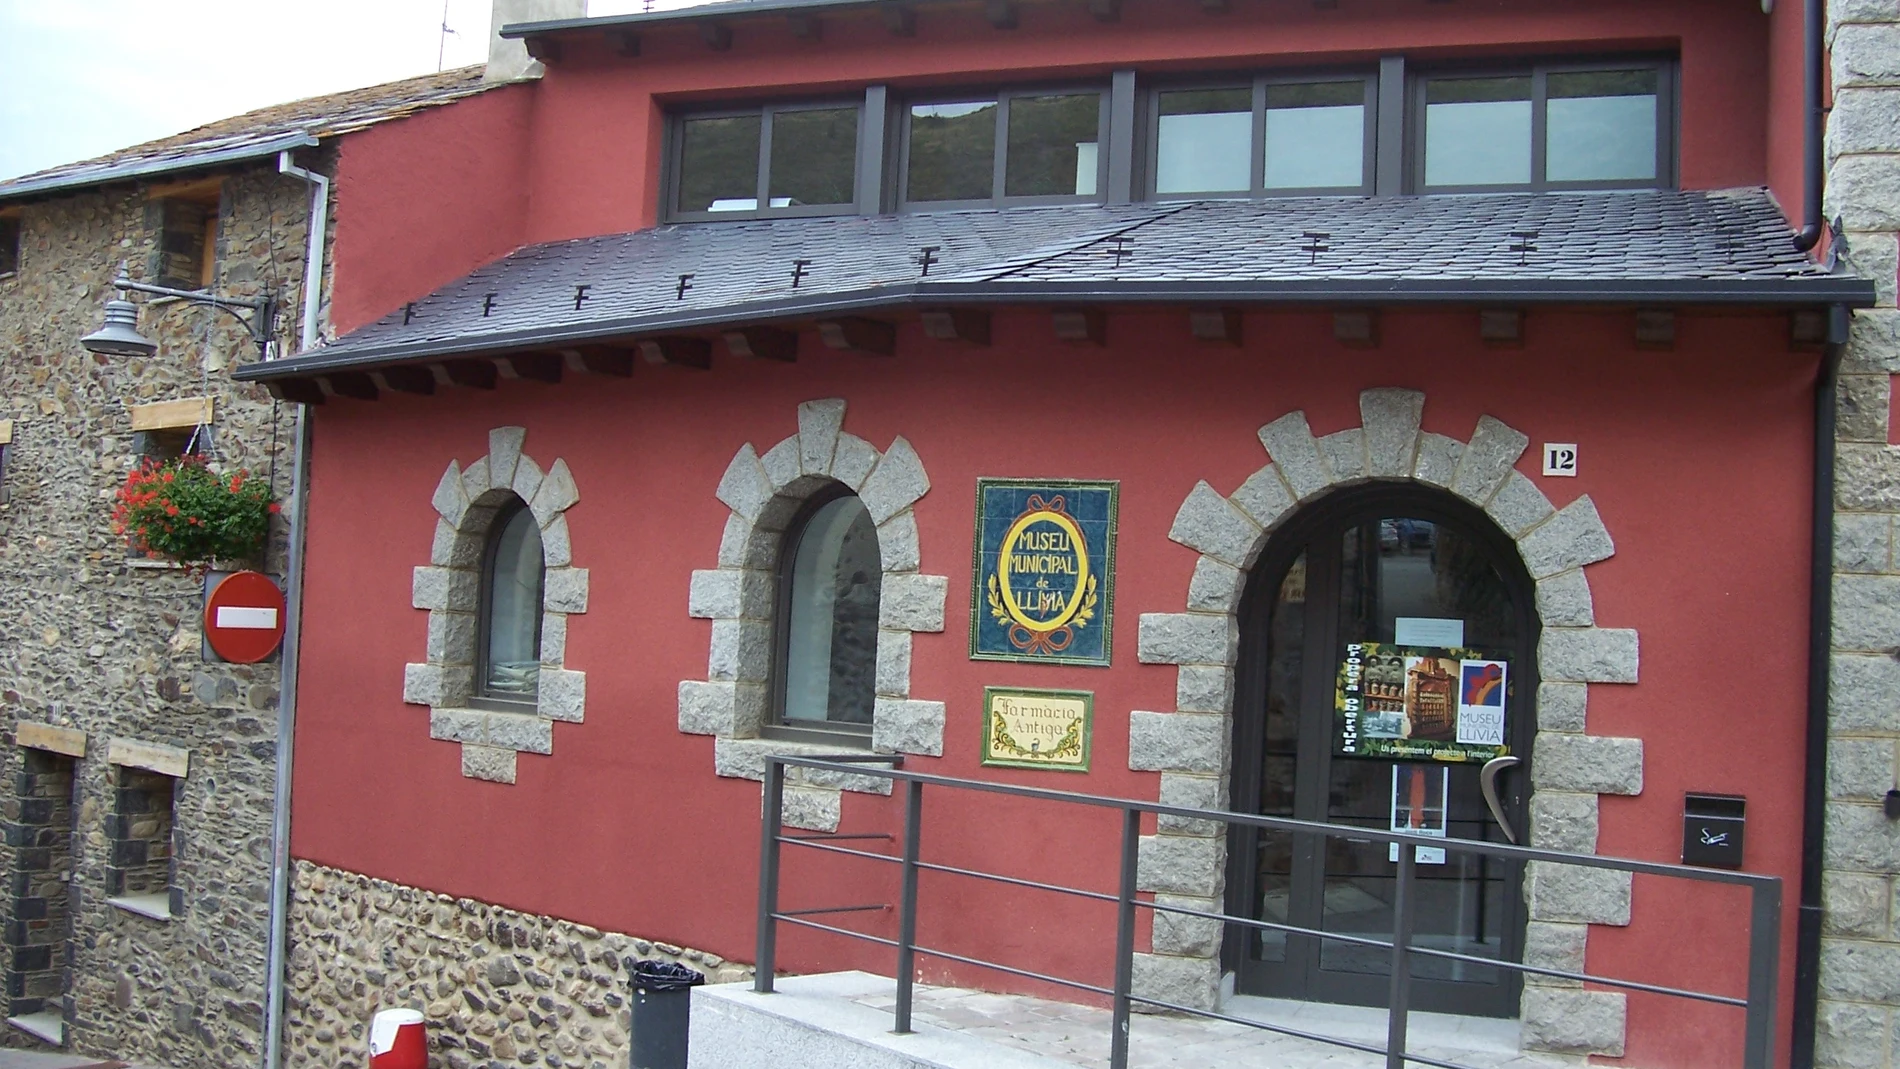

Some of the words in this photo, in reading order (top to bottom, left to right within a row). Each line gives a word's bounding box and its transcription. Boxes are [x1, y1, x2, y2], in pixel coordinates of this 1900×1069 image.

[1549, 450, 1574, 470] 12
[1019, 531, 1070, 551] MUSEU
[1009, 554, 1078, 574] MUNICIPAL
[1036, 577, 1049, 588] de
[1460, 712, 1502, 725] MUSEU
[1012, 719, 1063, 742] Antiga
